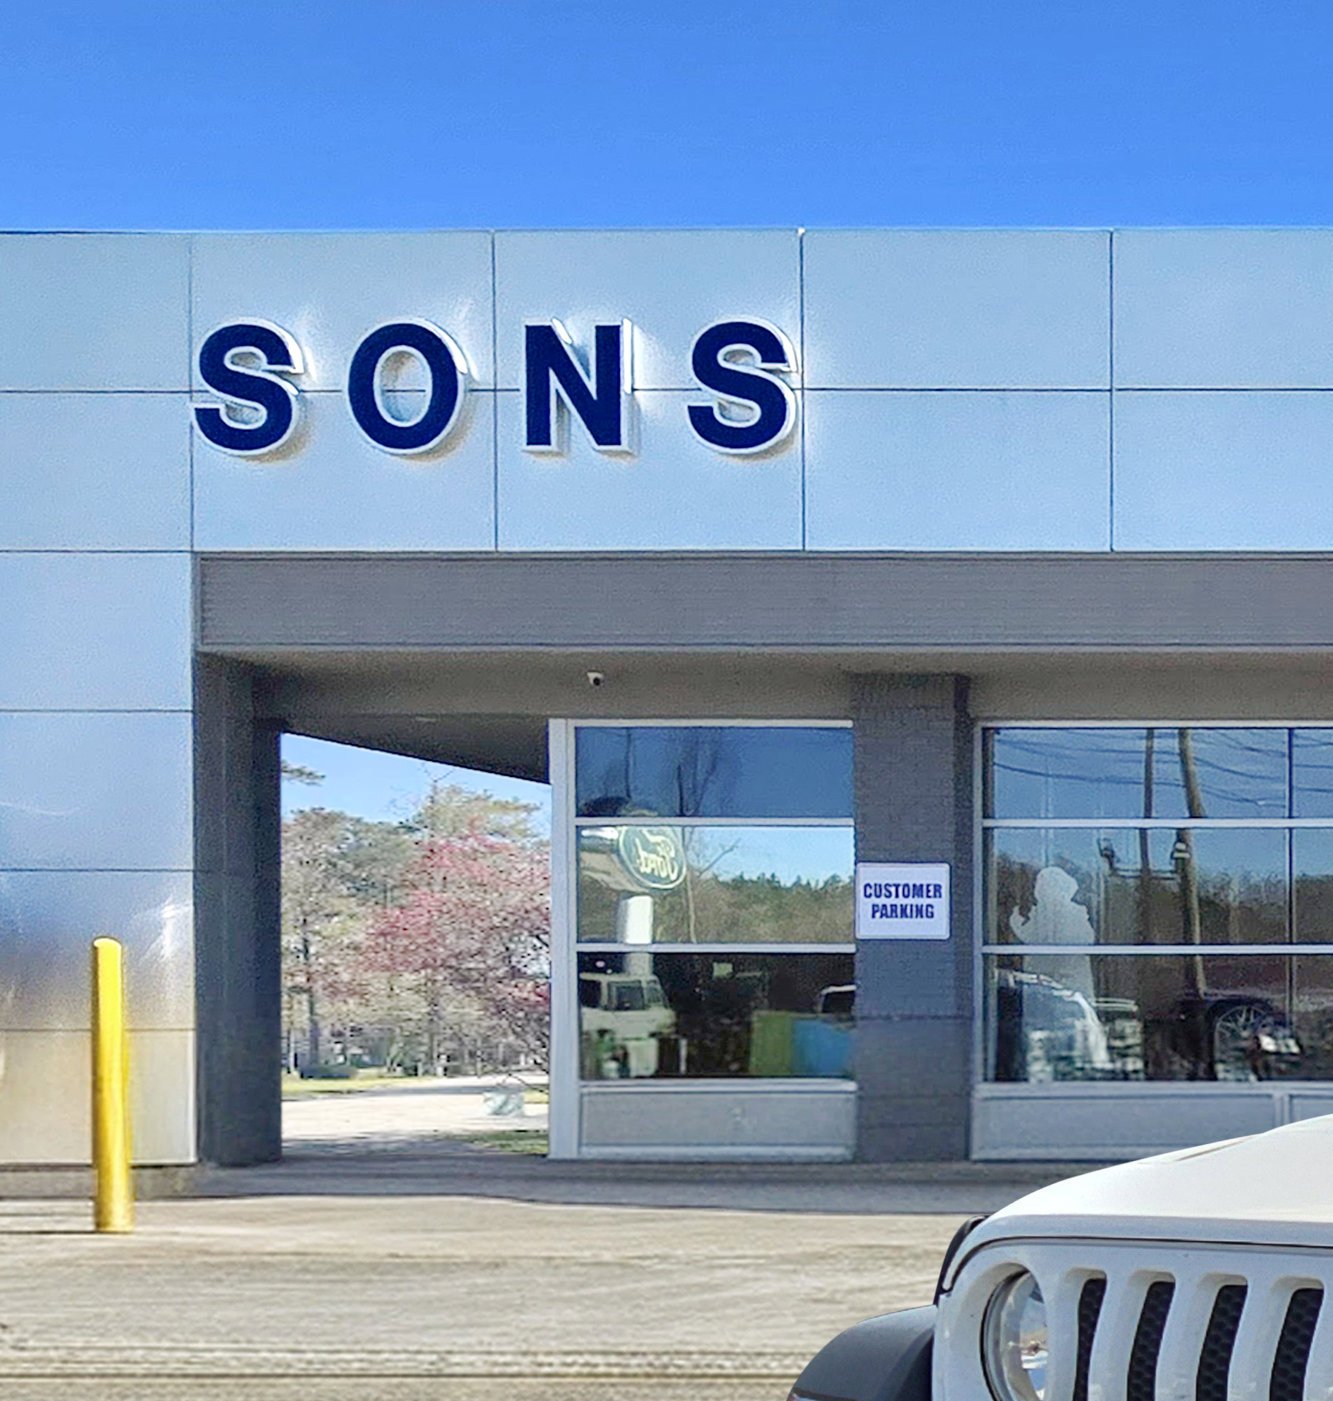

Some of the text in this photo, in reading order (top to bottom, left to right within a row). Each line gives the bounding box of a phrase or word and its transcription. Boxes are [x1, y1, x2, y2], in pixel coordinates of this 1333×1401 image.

[194, 319, 798, 455] SONS
[863, 882, 942, 899] CUSTOMER
[871, 903, 934, 919] PARKING
